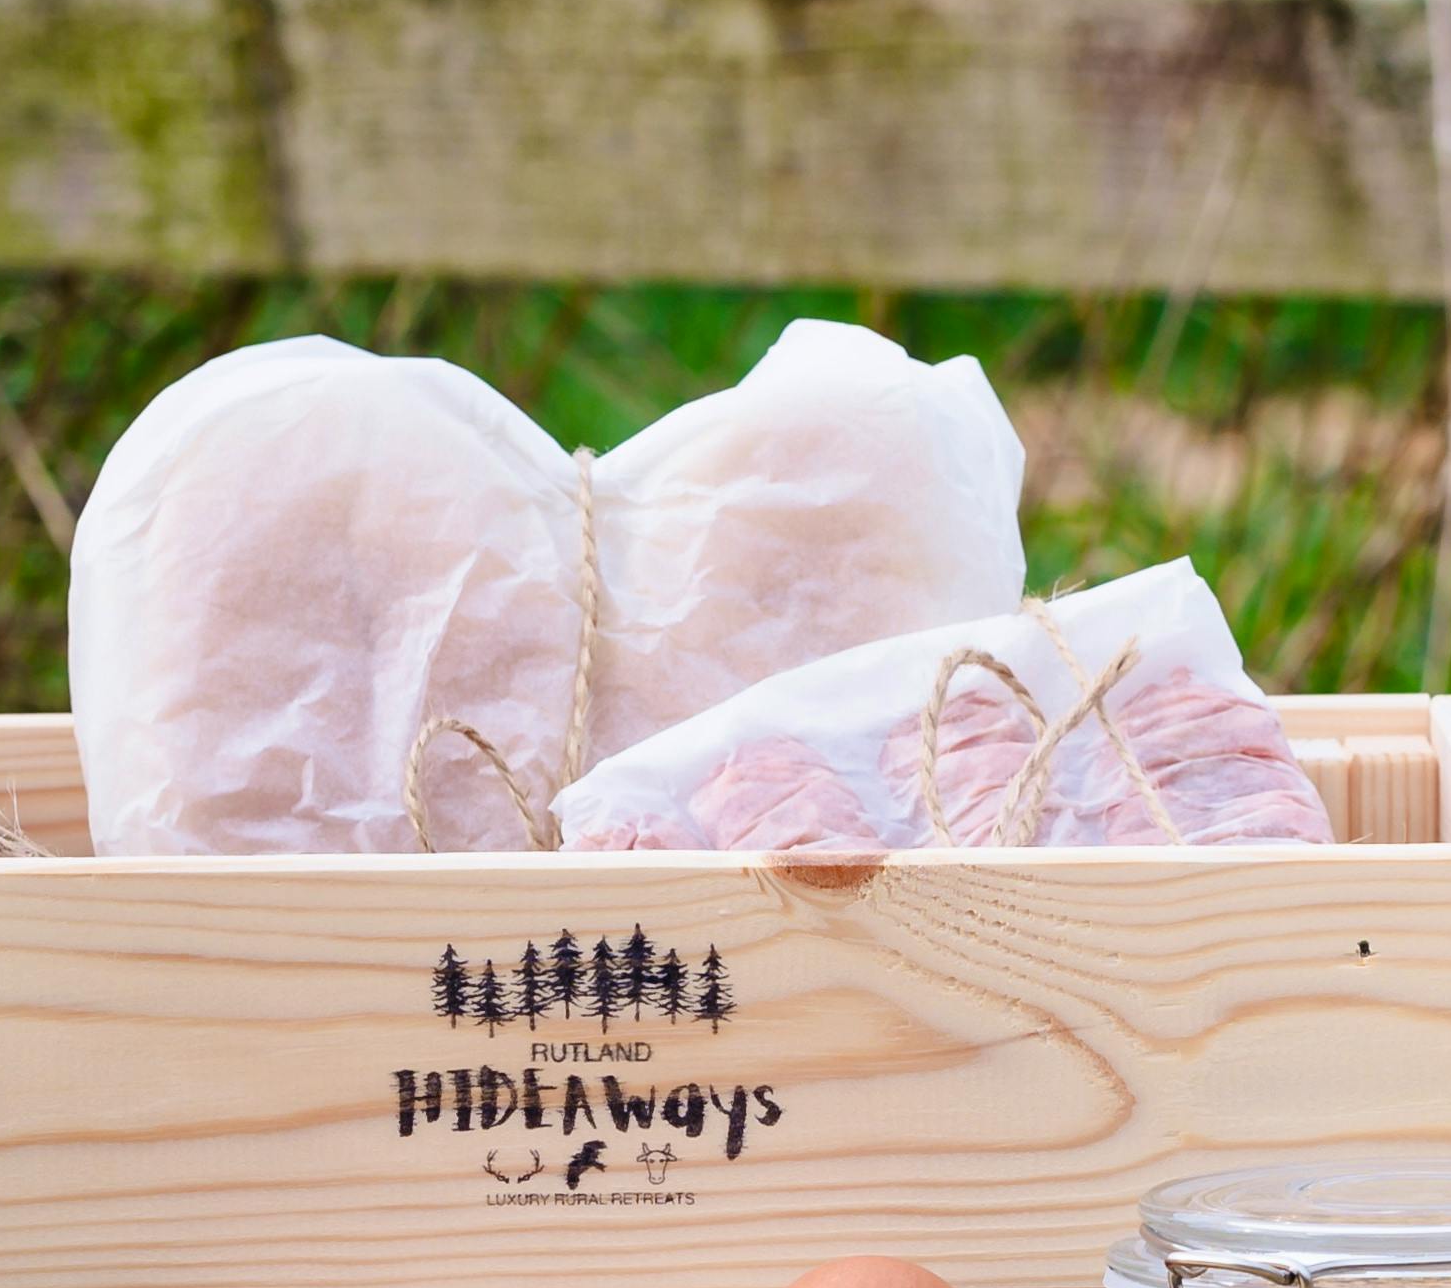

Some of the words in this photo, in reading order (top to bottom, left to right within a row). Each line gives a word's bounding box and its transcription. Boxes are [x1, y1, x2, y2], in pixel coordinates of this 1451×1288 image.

[531, 1042, 652, 1063] RUTLAND
[486, 1192, 550, 1206] LUXURY
[554, 1192, 608, 1205] RURAL
[611, 1192, 696, 1205] RETREATS
